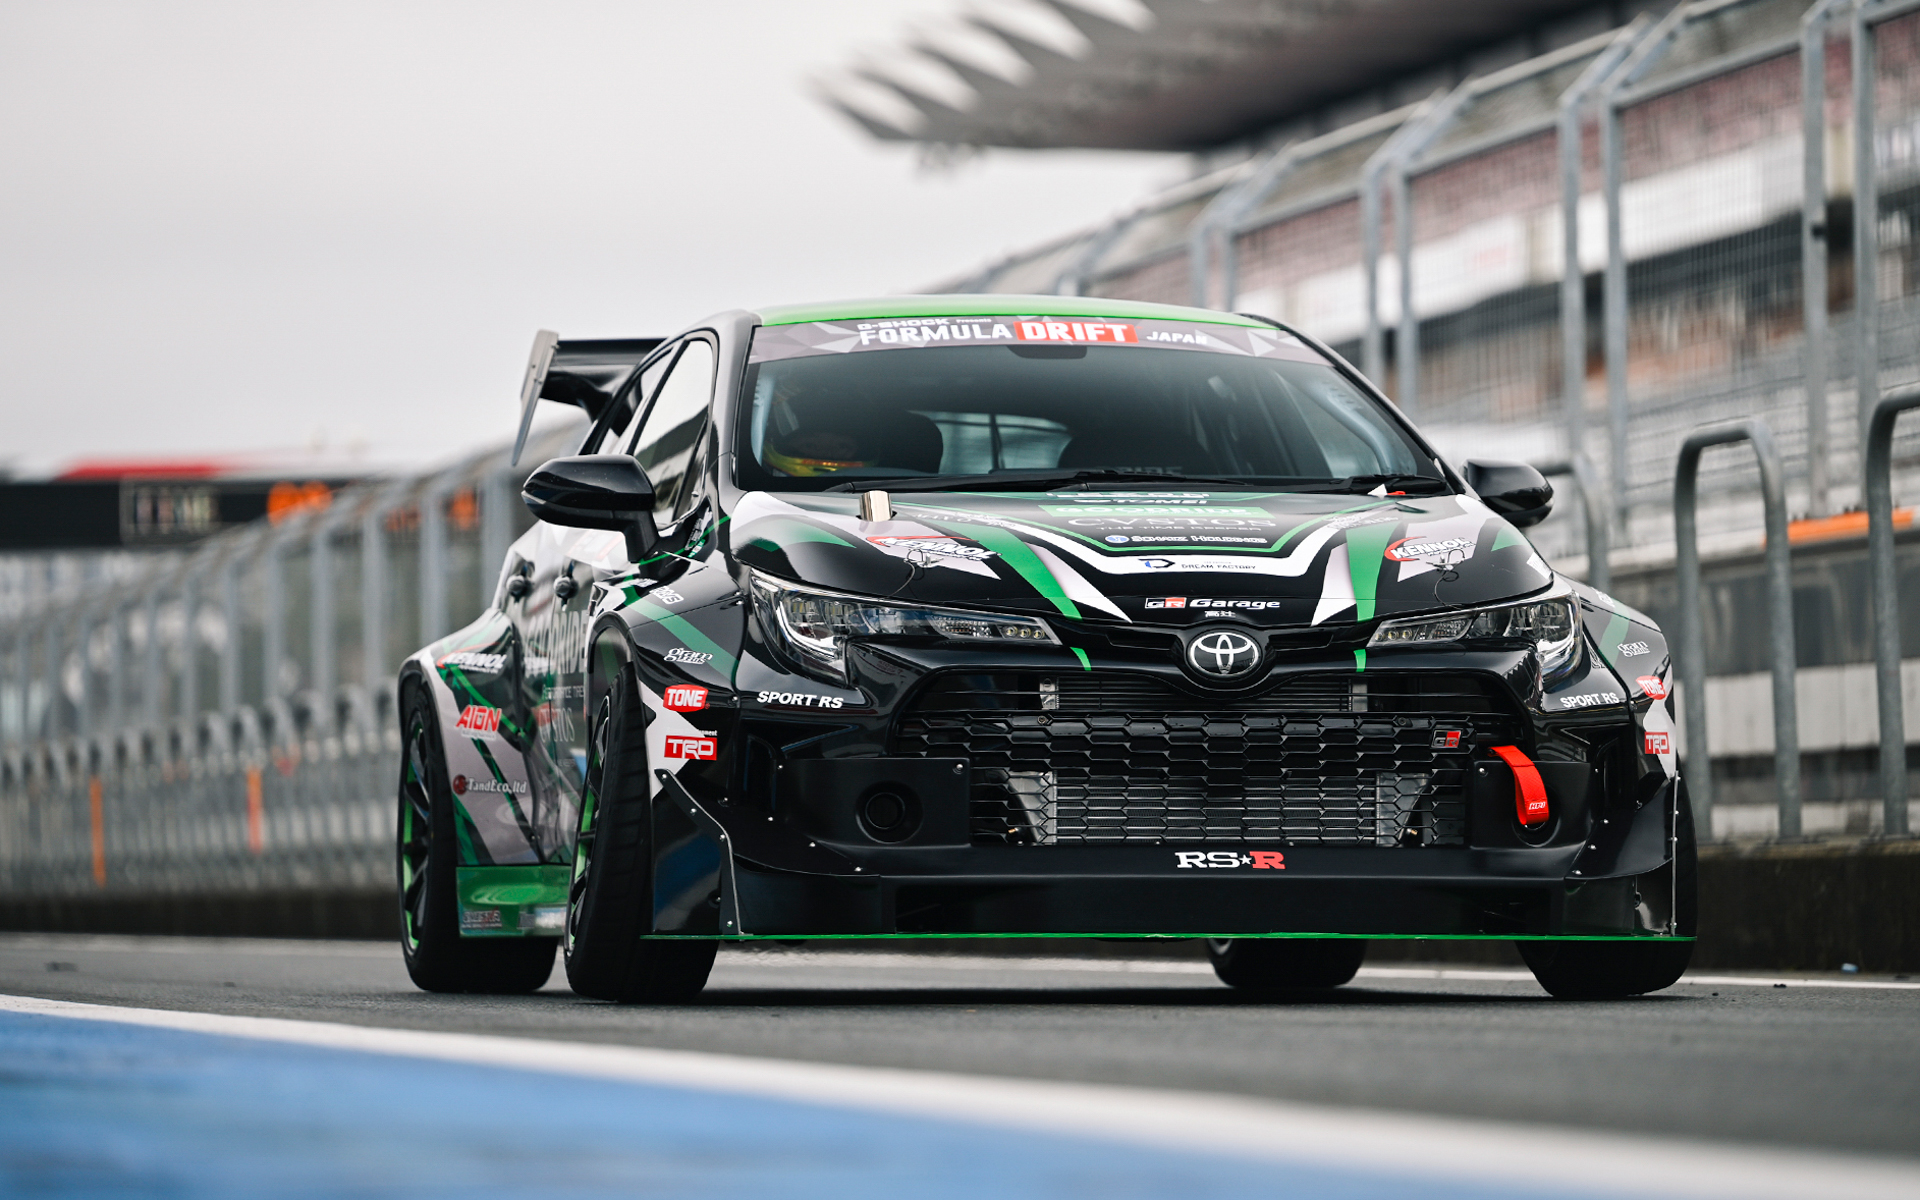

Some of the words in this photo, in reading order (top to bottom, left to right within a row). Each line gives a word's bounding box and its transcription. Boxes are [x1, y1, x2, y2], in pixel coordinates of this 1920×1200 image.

[859, 323, 1014, 345] FORMULA
[1021, 322, 1128, 342] DRIFT
[1146, 331, 1208, 345] JAPAN
[1056, 506, 1247, 514] GOODRIDE
[1068, 518, 1277, 527] CVSTOS
[1390, 538, 1473, 559] KENNOL
[1146, 599, 1185, 608] GR
[1189, 599, 1280, 609] Garage
[1639, 679, 1665, 696] TONE
[667, 688, 706, 707] TONE
[756, 690, 818, 706] SPORT
[818, 695, 844, 708] RS
[1560, 693, 1601, 708] SPORT
[1601, 692, 1620, 705] RS
[667, 738, 714, 760] TRD
[1432, 735, 1460, 748] GR
[1645, 734, 1668, 754] TRD
